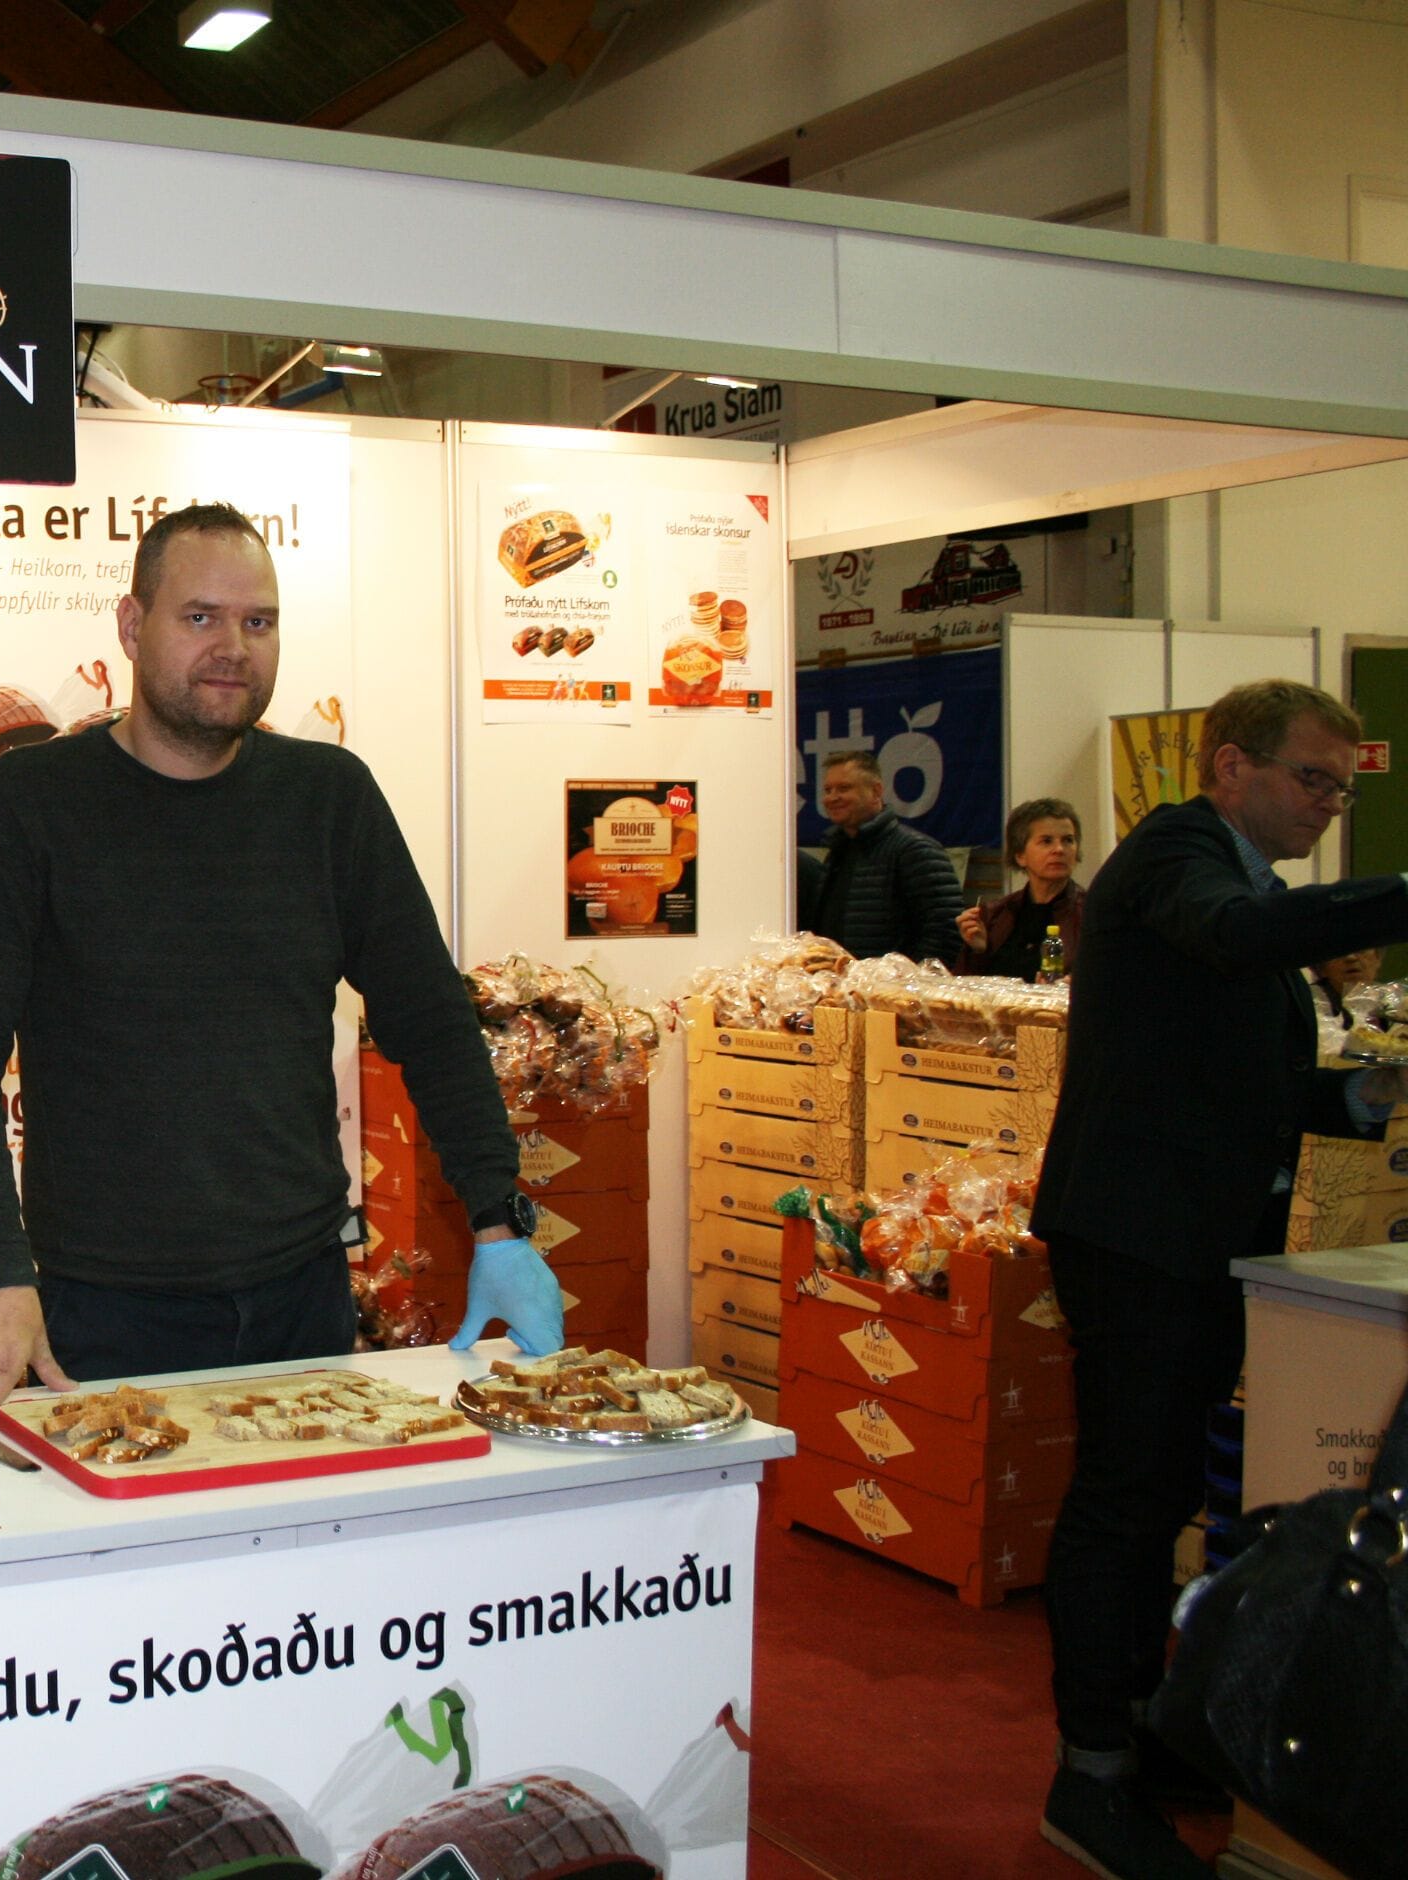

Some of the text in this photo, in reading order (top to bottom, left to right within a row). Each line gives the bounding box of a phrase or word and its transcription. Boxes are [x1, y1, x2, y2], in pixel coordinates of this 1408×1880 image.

[665, 401, 716, 436] Krua
[724, 382, 782, 424] Siam
[44, 501, 90, 540] er
[713, 525, 751, 539] skonsur
[11, 558, 133, 584] Heilkorn, trefj
[610, 822, 657, 837] BRIOCHE
[1315, 1427, 1386, 1448] Smakkað
[1328, 1459, 1347, 1480] og
[108, 1611, 354, 1706] skoðaðu
[379, 1609, 446, 1671] og
[468, 1553, 732, 1647] smakkaðu
